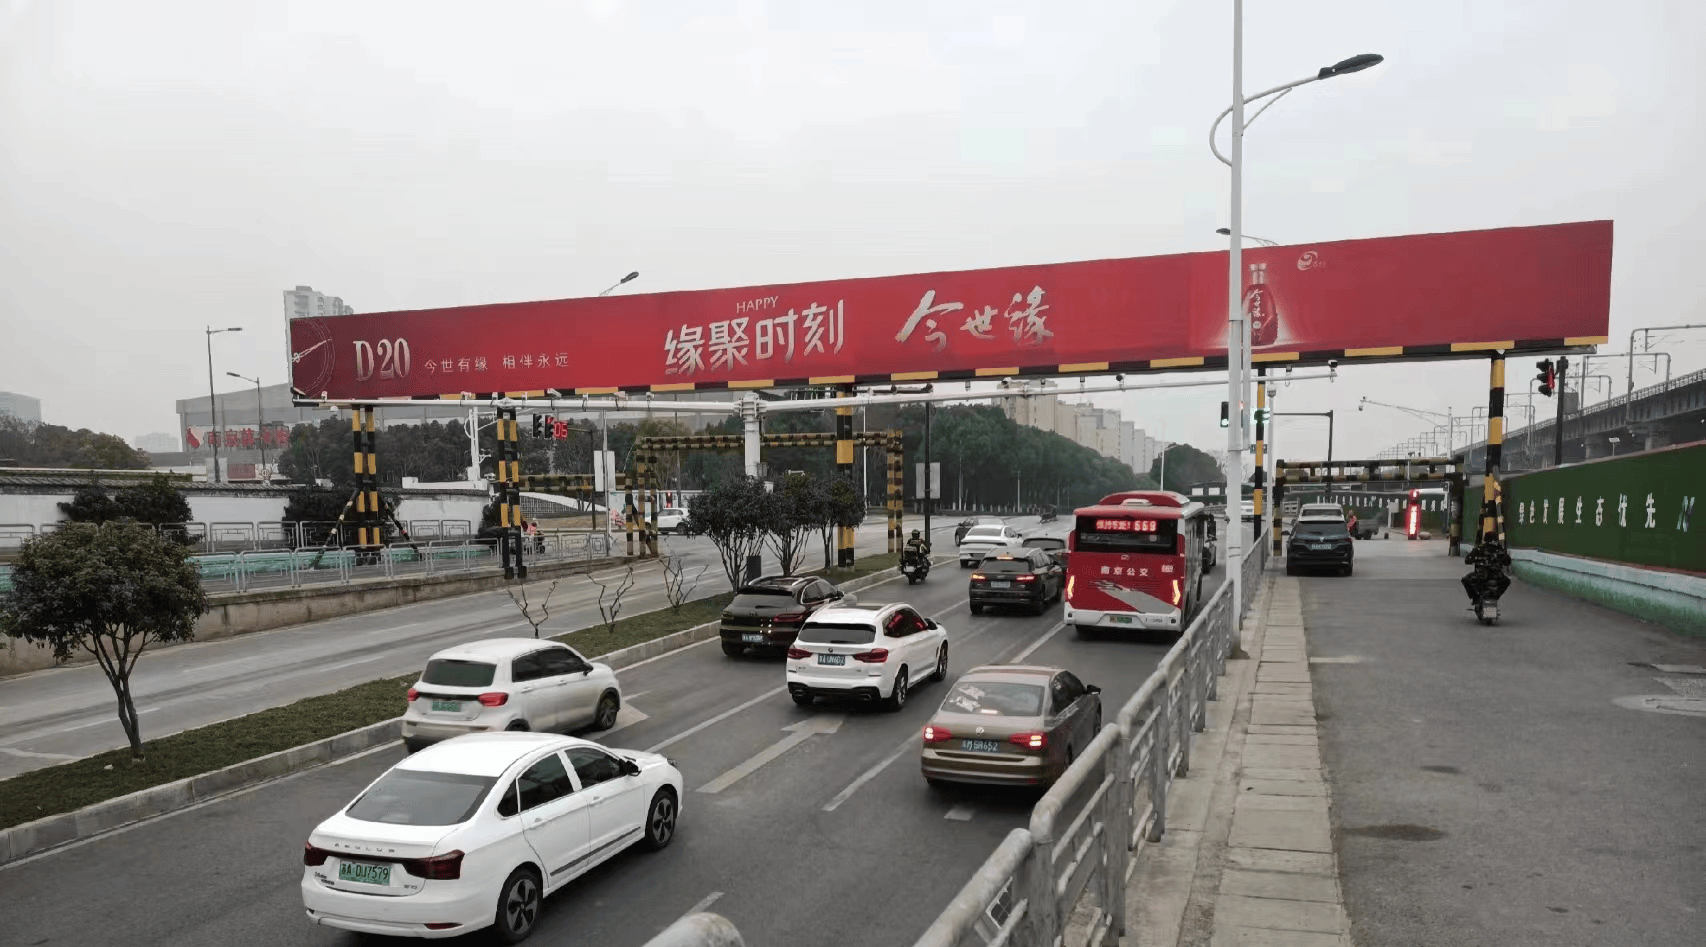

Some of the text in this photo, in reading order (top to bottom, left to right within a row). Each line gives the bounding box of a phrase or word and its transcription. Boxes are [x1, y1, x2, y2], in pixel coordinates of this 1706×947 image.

[736, 296, 778, 314] HAPPY
[895, 285, 1054, 352] 今世缘
[664, 299, 844, 376] 缘聚时刻
[353, 337, 410, 381] D20
[424, 352, 569, 374] 今世有缘 相伴永远
[1100, 565, 1149, 577] 南京公交
